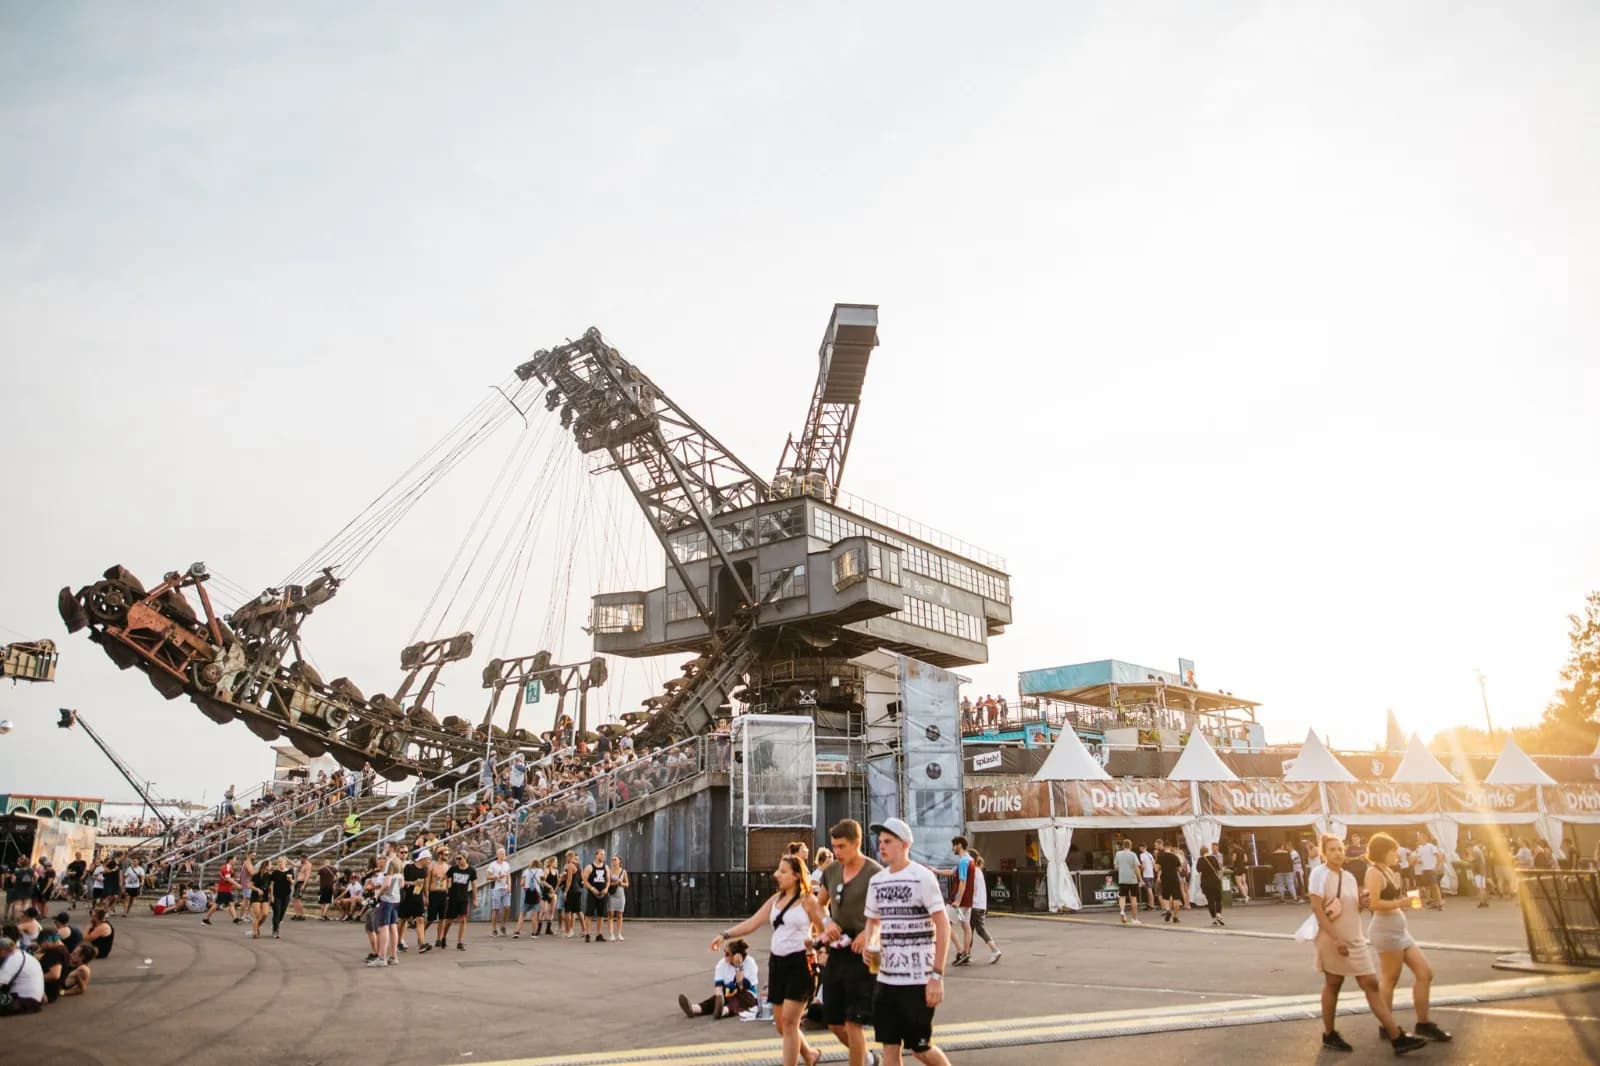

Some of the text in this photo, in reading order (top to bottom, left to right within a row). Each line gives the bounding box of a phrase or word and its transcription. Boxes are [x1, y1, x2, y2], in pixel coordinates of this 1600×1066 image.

[978, 790, 1022, 814] Drinks
[1091, 784, 1161, 809] Drinks
[1231, 785, 1295, 809] Drinks
[1356, 786, 1412, 808] Drinks
[1095, 890, 1121, 900] BECK
